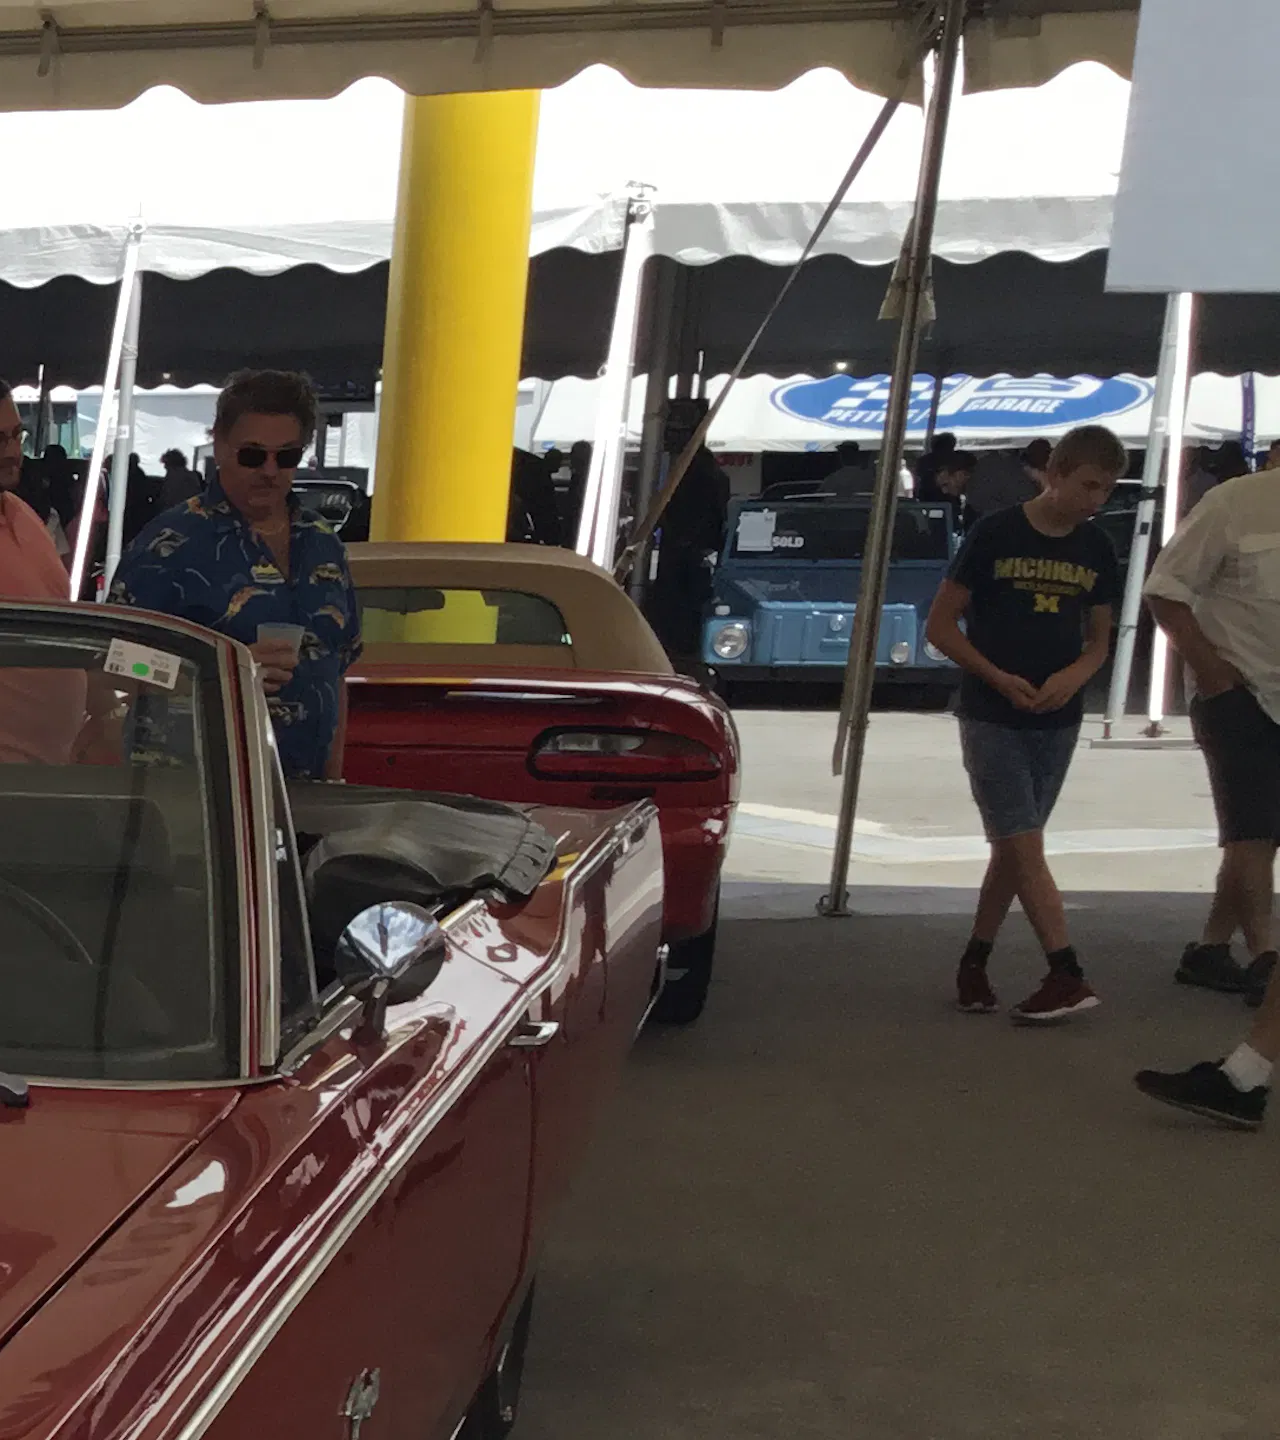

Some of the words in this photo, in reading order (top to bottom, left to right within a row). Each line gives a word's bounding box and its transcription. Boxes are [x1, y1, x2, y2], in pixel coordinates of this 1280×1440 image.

[963, 398, 1064, 414] GARAGE
[772, 535, 804, 548] SOLD
[994, 557, 1099, 592] MICHIGAN
[1034, 593, 1060, 613] M
